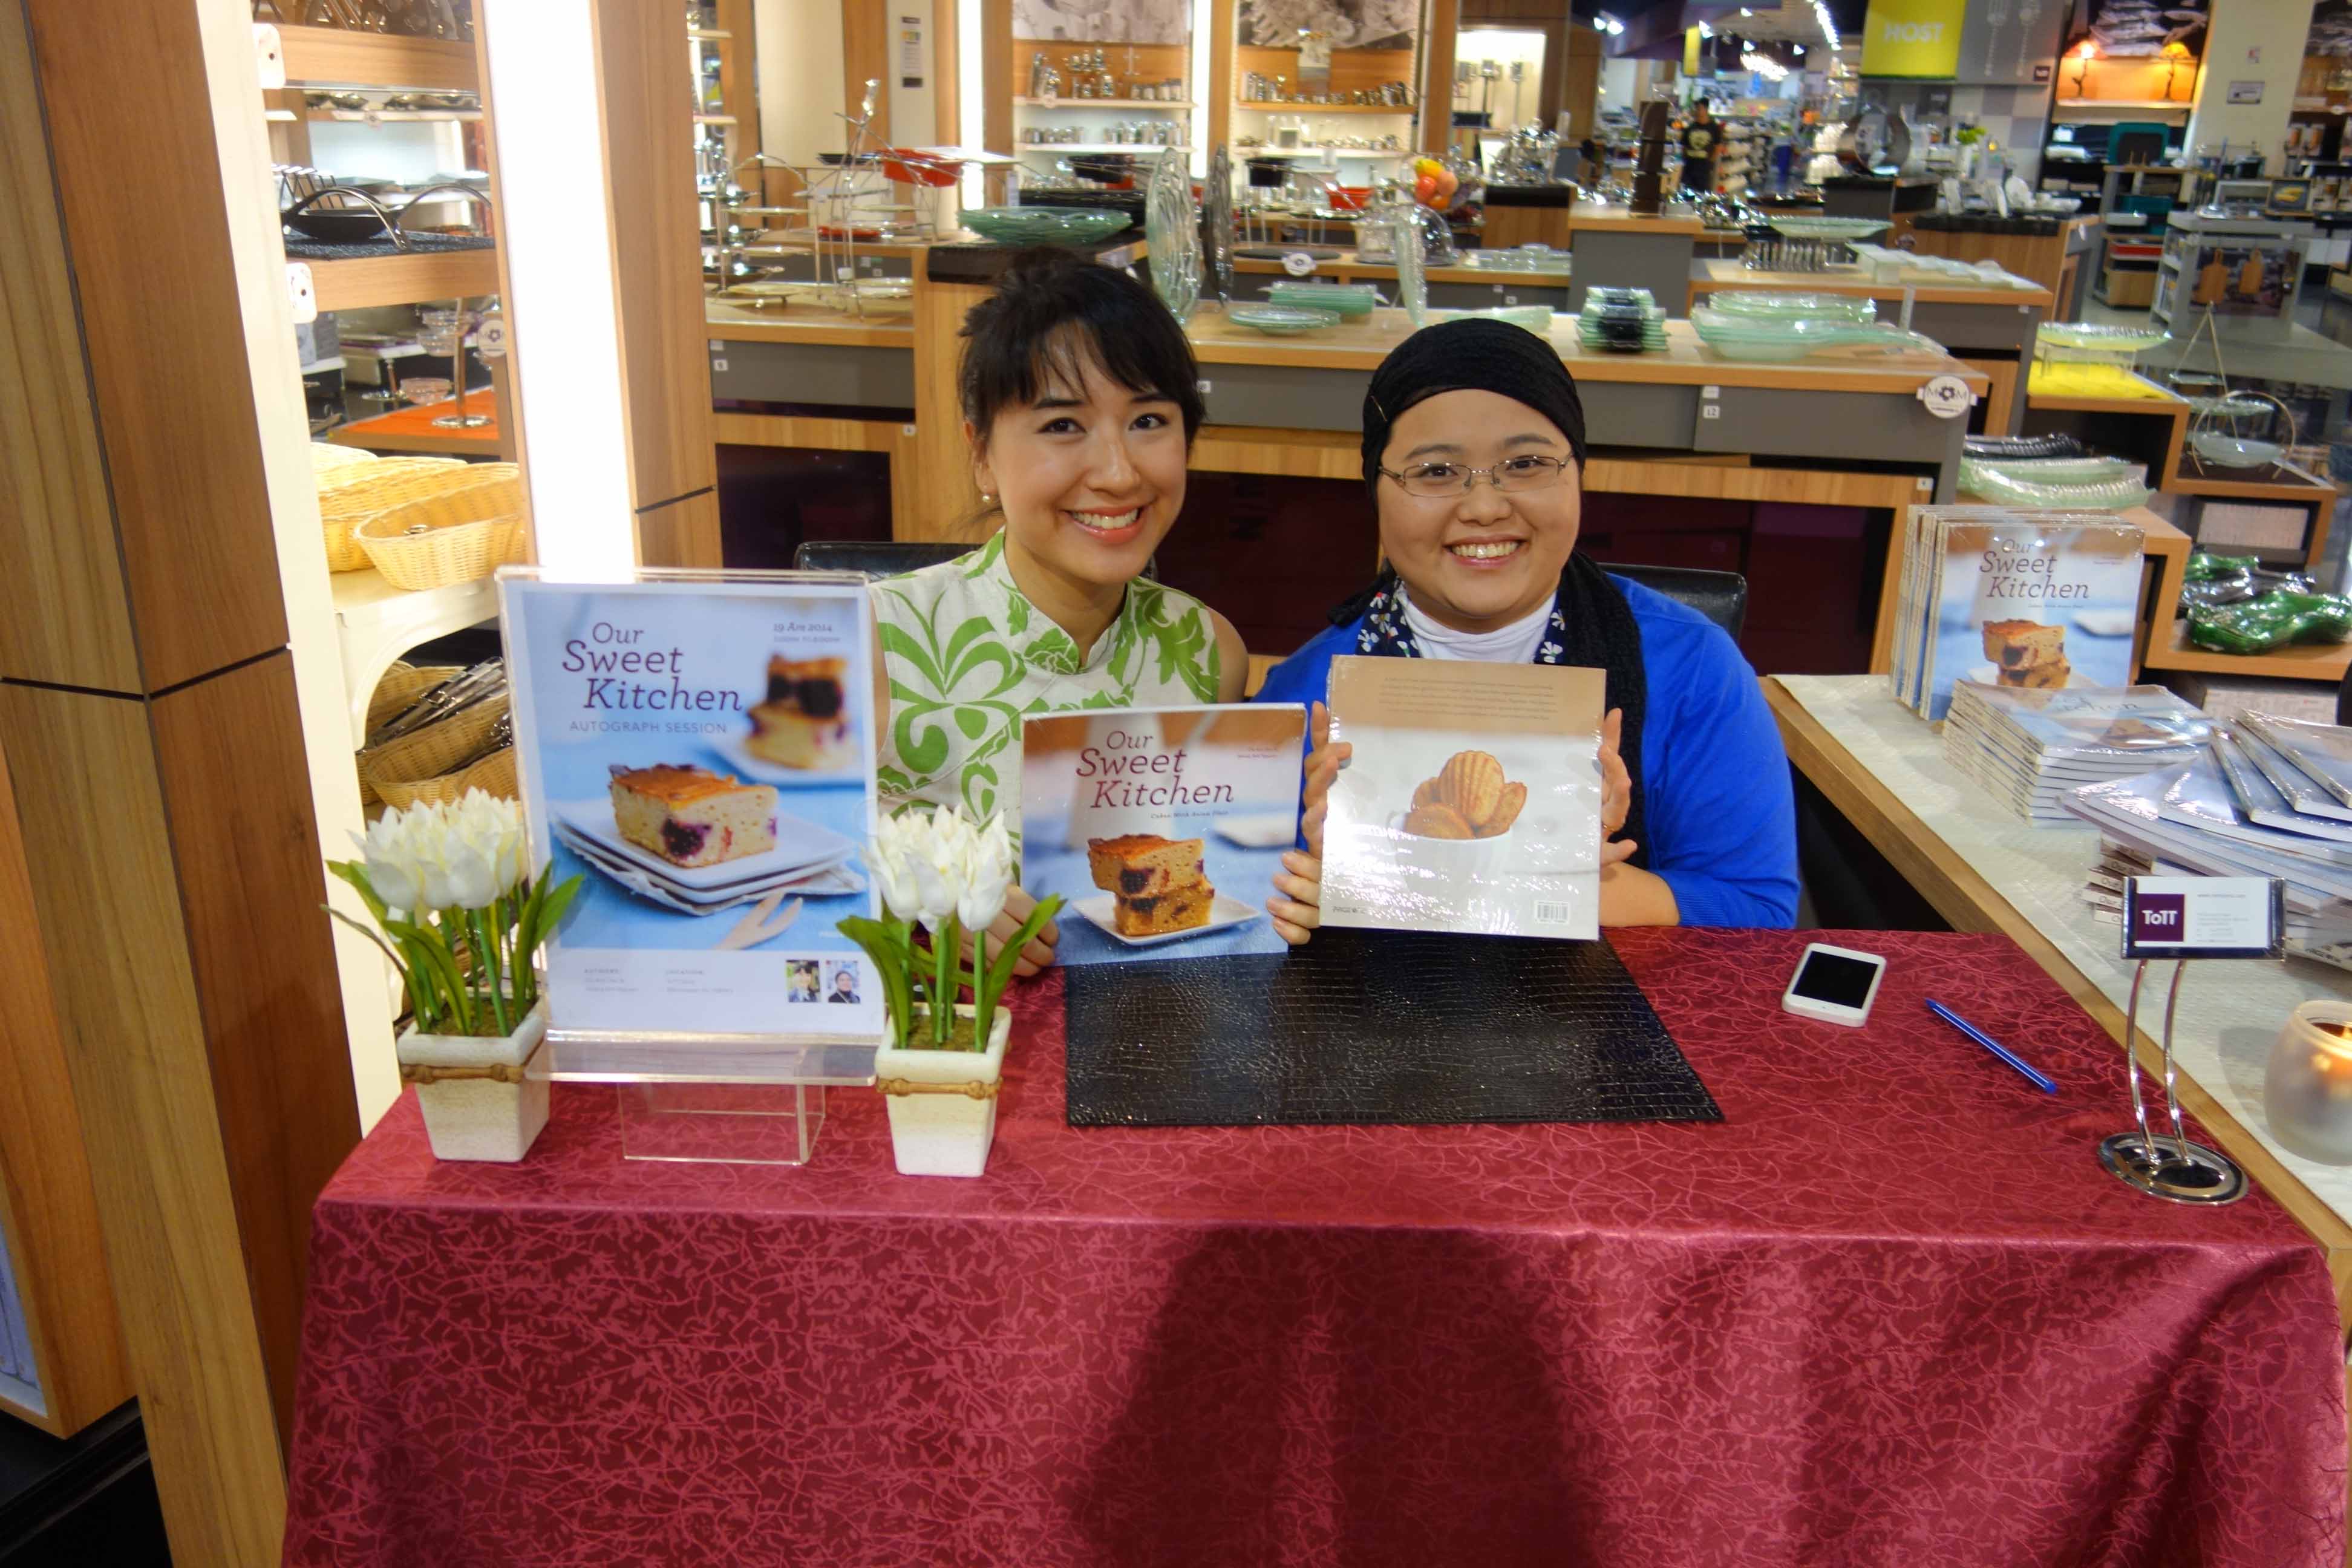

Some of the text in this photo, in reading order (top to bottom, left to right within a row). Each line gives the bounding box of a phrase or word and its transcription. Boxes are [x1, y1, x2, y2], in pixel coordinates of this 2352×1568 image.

[1883, 22, 1945, 43] HOST
[2001, 538, 2033, 554] Our
[1979, 551, 2057, 573] Sweet
[1986, 575, 2089, 599] Kitchen
[592, 622, 644, 644] Our
[562, 639, 684, 673] Sweet
[583, 676, 743, 712] Kitchen
[569, 720, 727, 734] AUTOGRAPH SESSION
[1106, 730, 1154, 750] Our
[1076, 748, 1187, 777] Sweet
[1090, 775, 1234, 808] Kitchen
